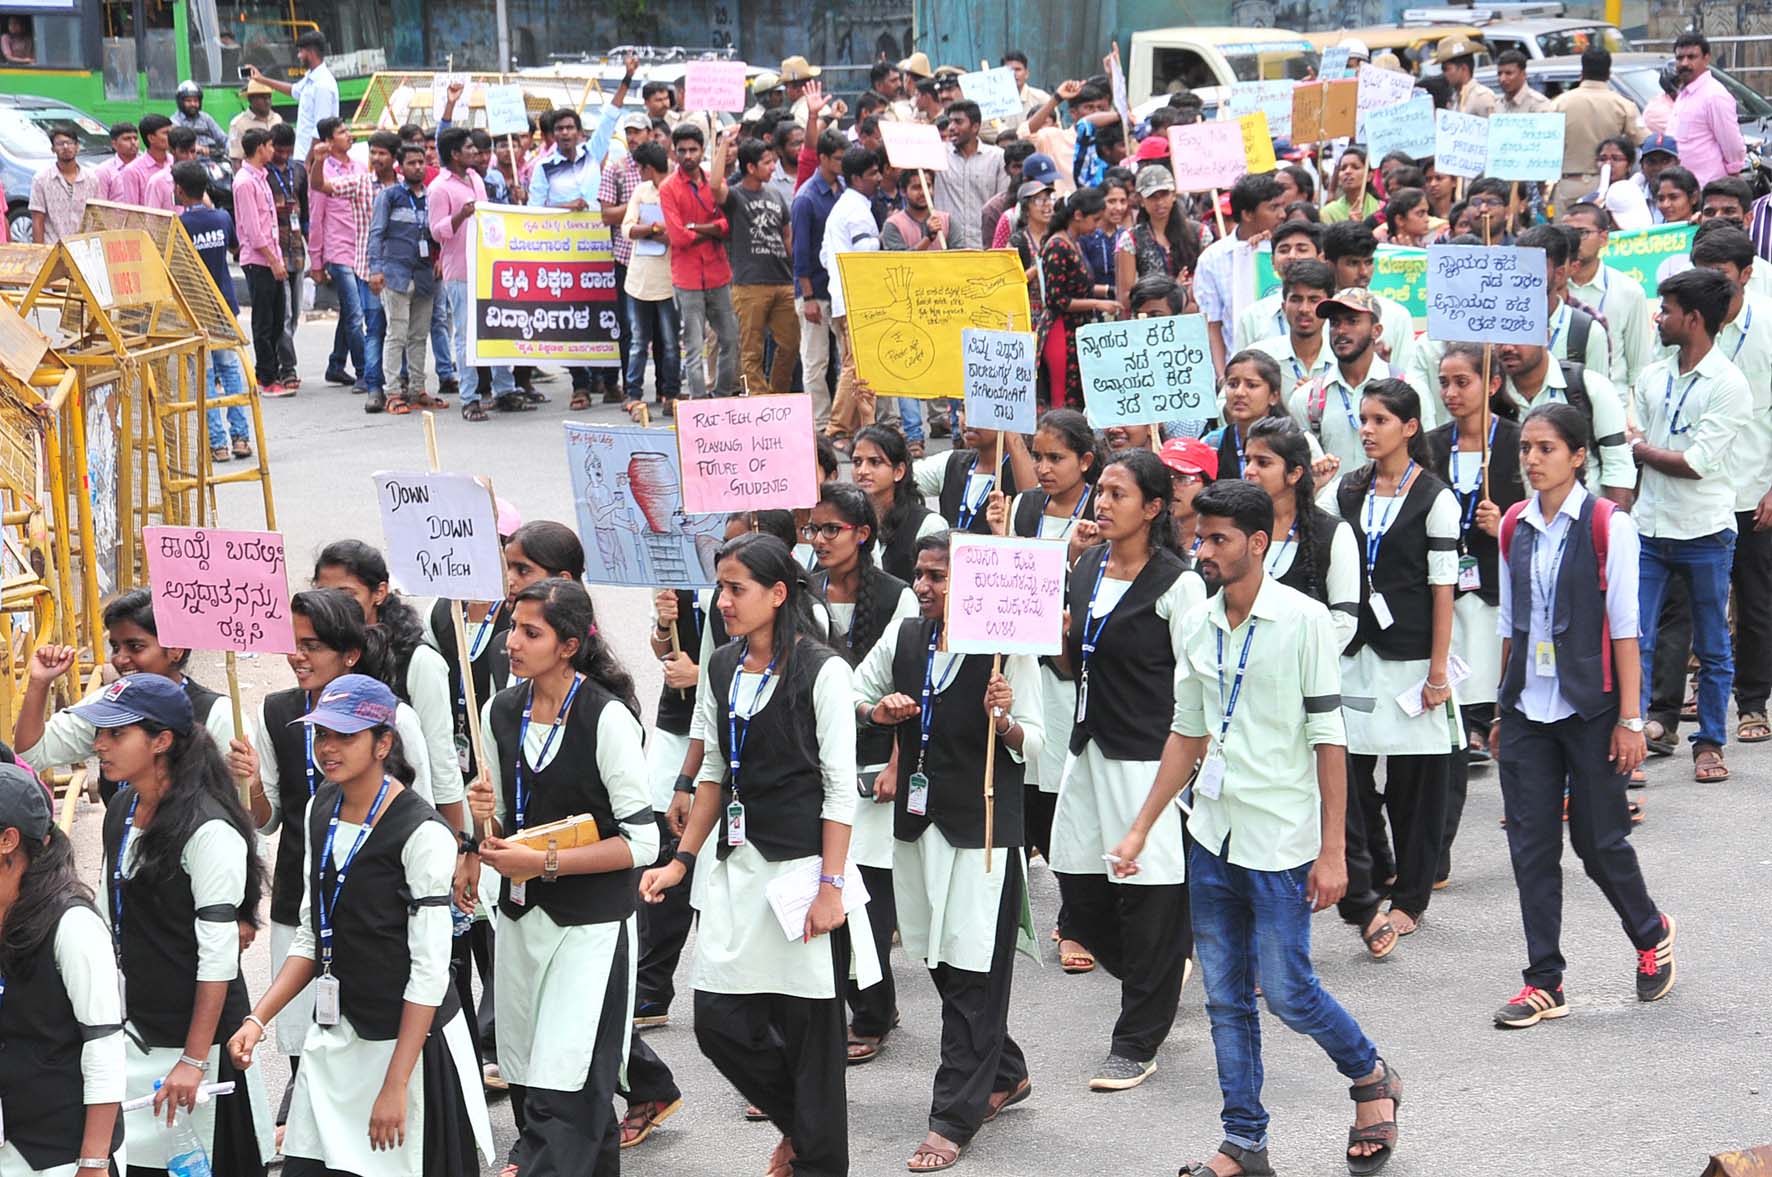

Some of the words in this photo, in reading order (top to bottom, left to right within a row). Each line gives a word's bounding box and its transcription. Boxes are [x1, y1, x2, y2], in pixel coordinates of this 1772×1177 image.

[501, 267, 529, 298] ಕೃಷಿ
[536, 267, 573, 298] ಶಿಕ್ಷಣ
[485, 305, 590, 339] ವಿದ್ಯಾರ್ಥಿಗಳ
[1146, 320, 1175, 346] ಕಡೆ
[1166, 366, 1192, 386] ಕಡೆ
[1152, 388, 1200, 412] ಇರಲಿ
[695, 437, 743, 454] PLAYING
[752, 436, 784, 452] WITH
[696, 459, 739, 477] FUTURE
[748, 458, 767, 472] OF
[385, 480, 429, 513] DOWN
[723, 478, 788, 496] STUDENTS
[426, 515, 474, 540] DOWN
